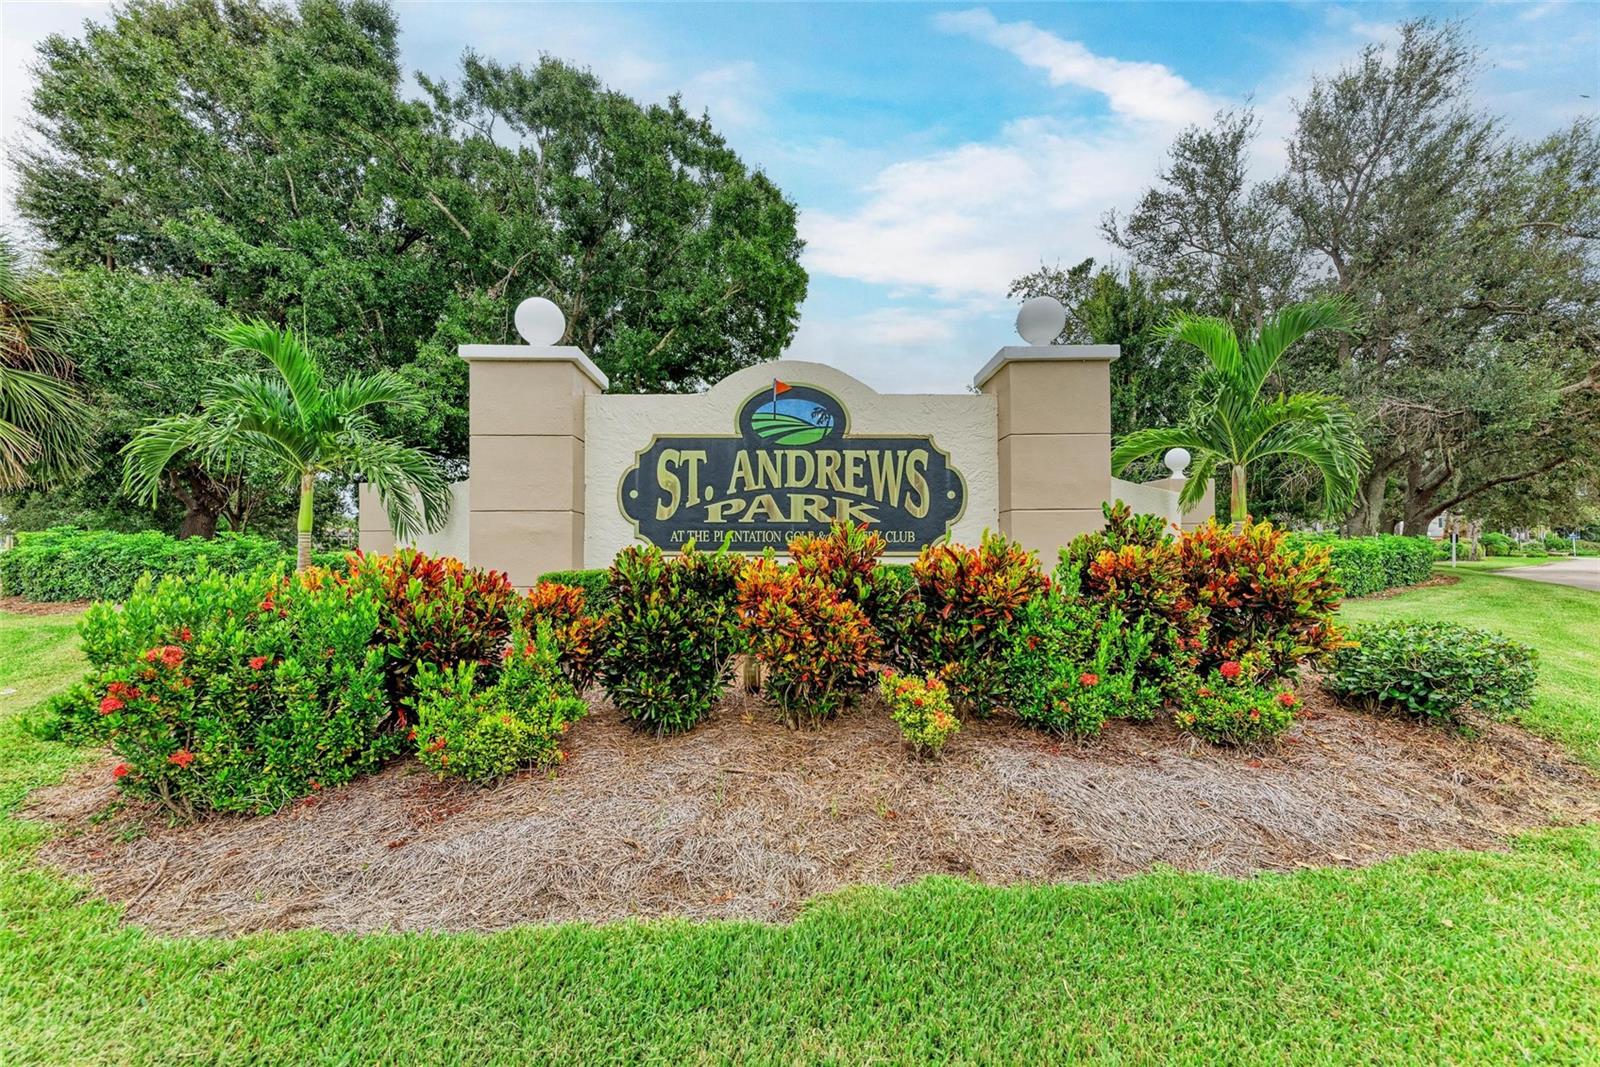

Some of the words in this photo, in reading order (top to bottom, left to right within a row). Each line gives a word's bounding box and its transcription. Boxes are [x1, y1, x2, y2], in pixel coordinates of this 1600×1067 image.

[655, 448, 714, 521] ST.
[726, 448, 930, 519] ANDREWS
[703, 493, 881, 523] PARK
[670, 530, 685, 542] AT
[687, 530, 710, 542] THE
[885, 531, 916, 543] CLUB
